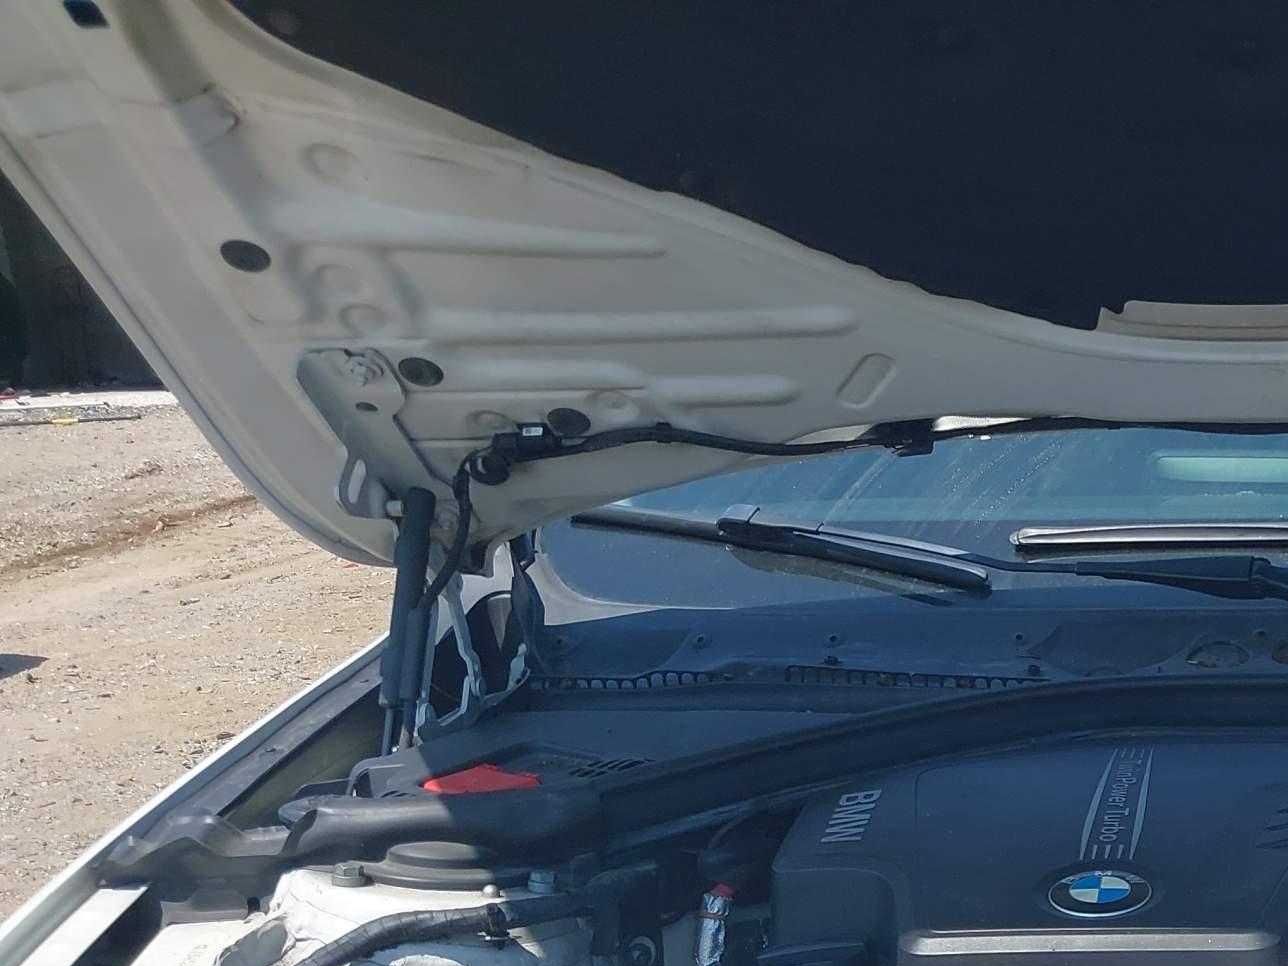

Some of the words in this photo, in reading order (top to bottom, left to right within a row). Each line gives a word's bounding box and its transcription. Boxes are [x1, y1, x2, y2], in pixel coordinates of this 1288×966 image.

[1107, 759, 1142, 807] TwinPower
[820, 789, 882, 843] BMW
[1098, 807, 1130, 842] Turbo
